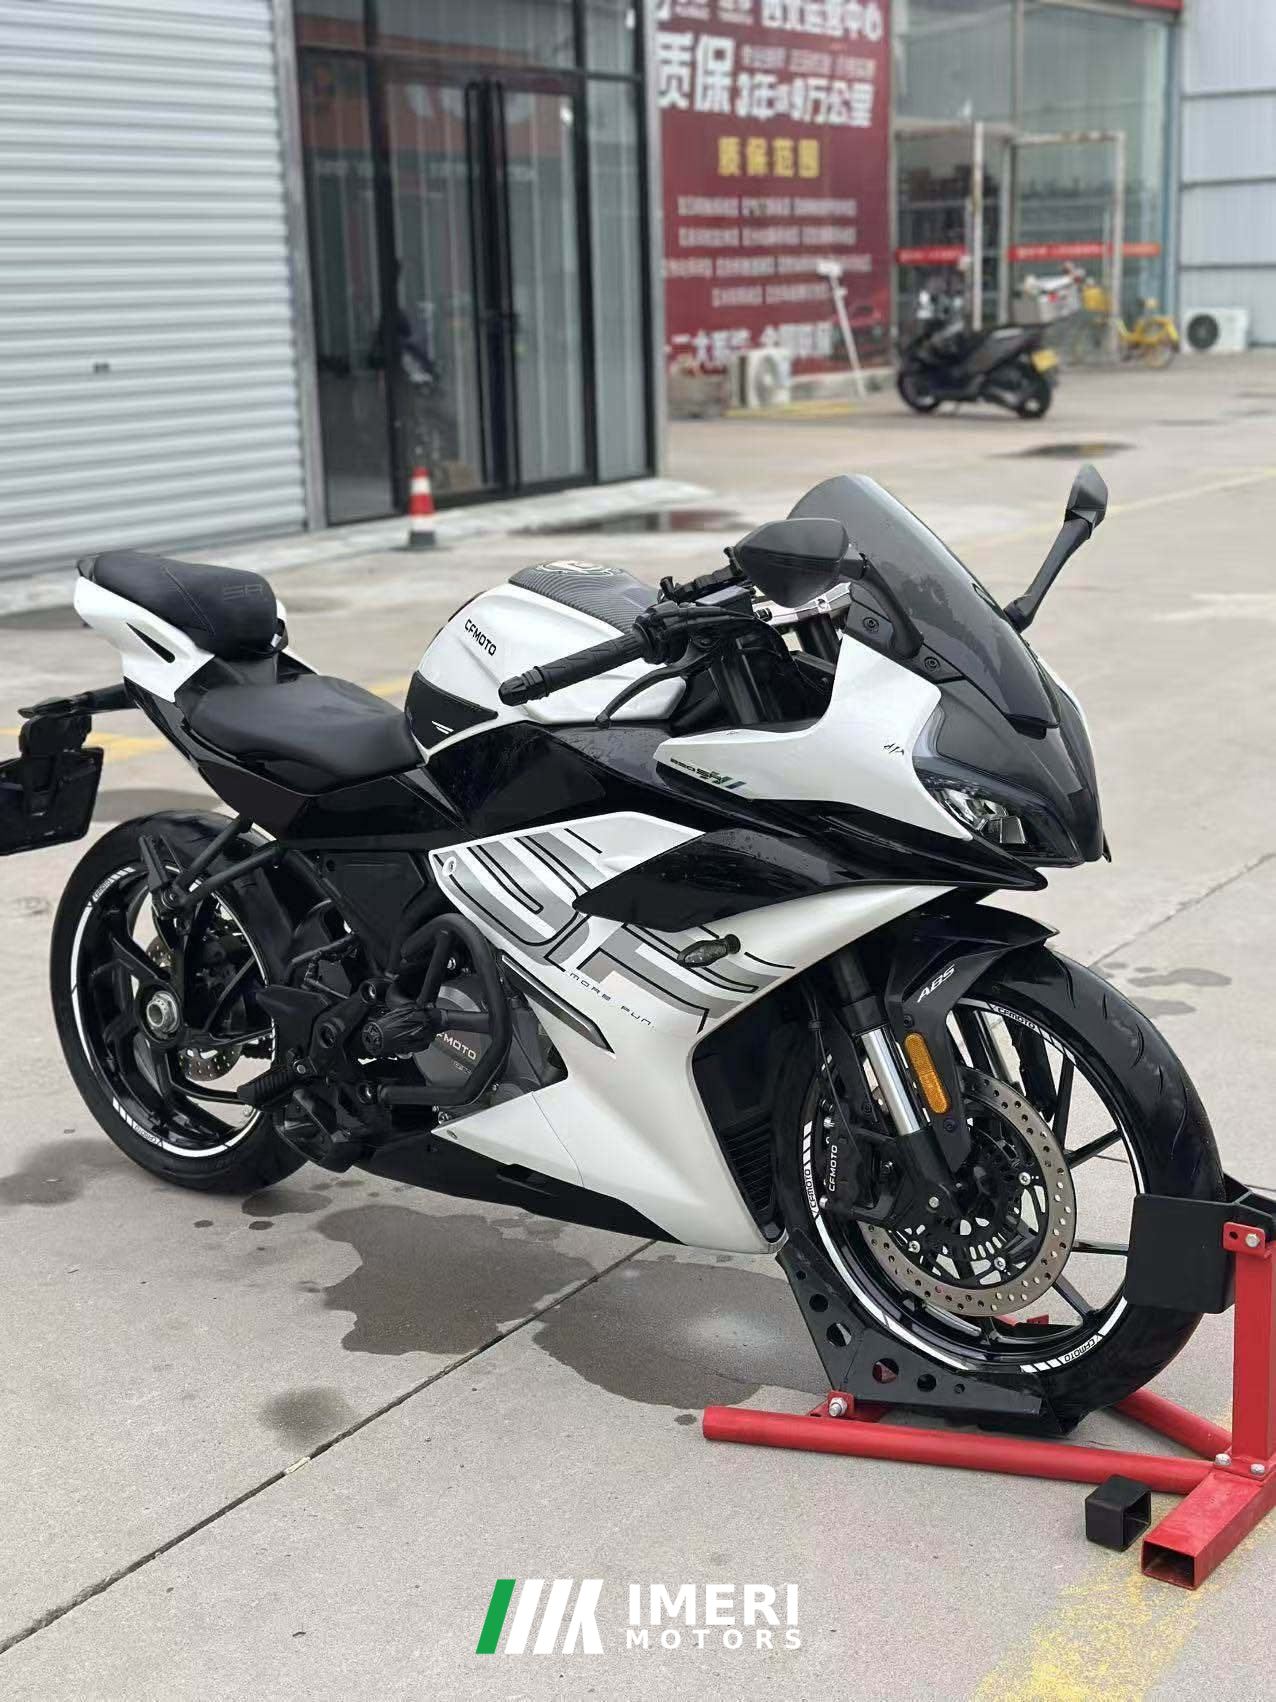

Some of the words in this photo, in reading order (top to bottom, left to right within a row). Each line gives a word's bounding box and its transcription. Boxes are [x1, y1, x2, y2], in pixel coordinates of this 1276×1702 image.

[464, 619, 497, 656] CFMOTO
[917, 964, 955, 1003] ABS
[828, 1144, 838, 1192] CFMOTO
[1064, 1338, 1096, 1362] CFMOTO
